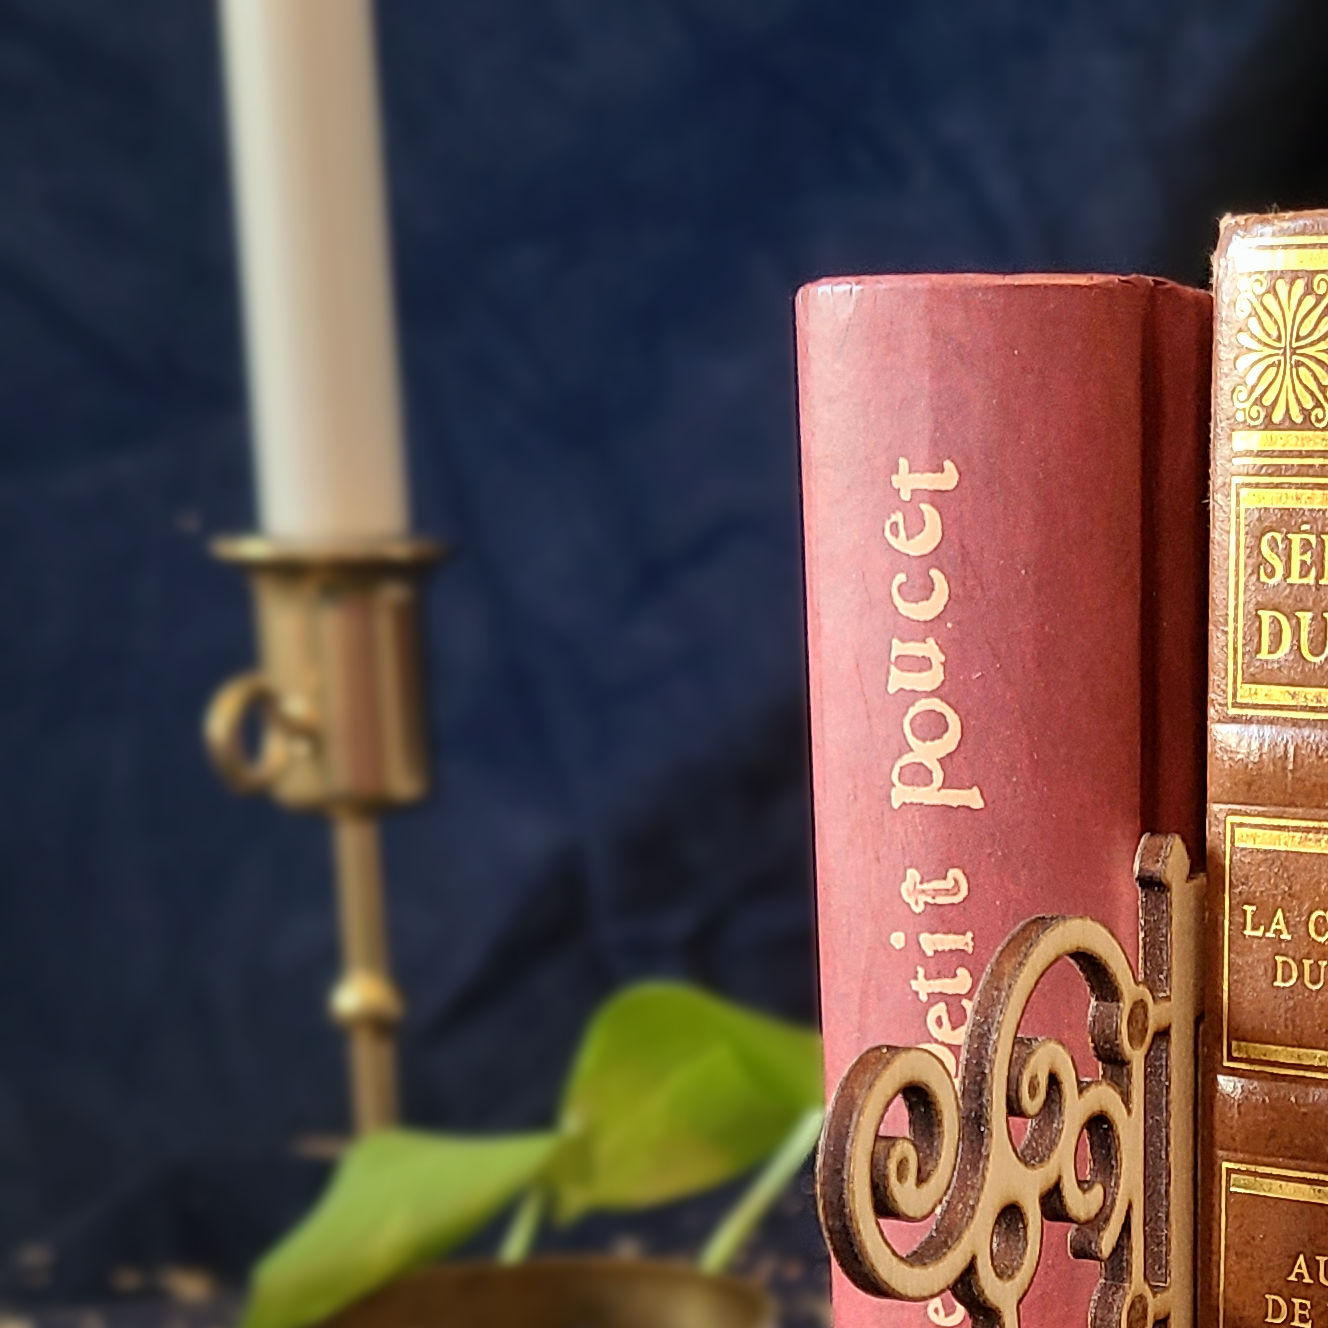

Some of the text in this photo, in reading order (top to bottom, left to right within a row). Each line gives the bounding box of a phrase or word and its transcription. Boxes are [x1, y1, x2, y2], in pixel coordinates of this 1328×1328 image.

[883, 457, 985, 810] poucet
[1242, 905, 1292, 941] LA
[1273, 955, 1328, 991] DU
